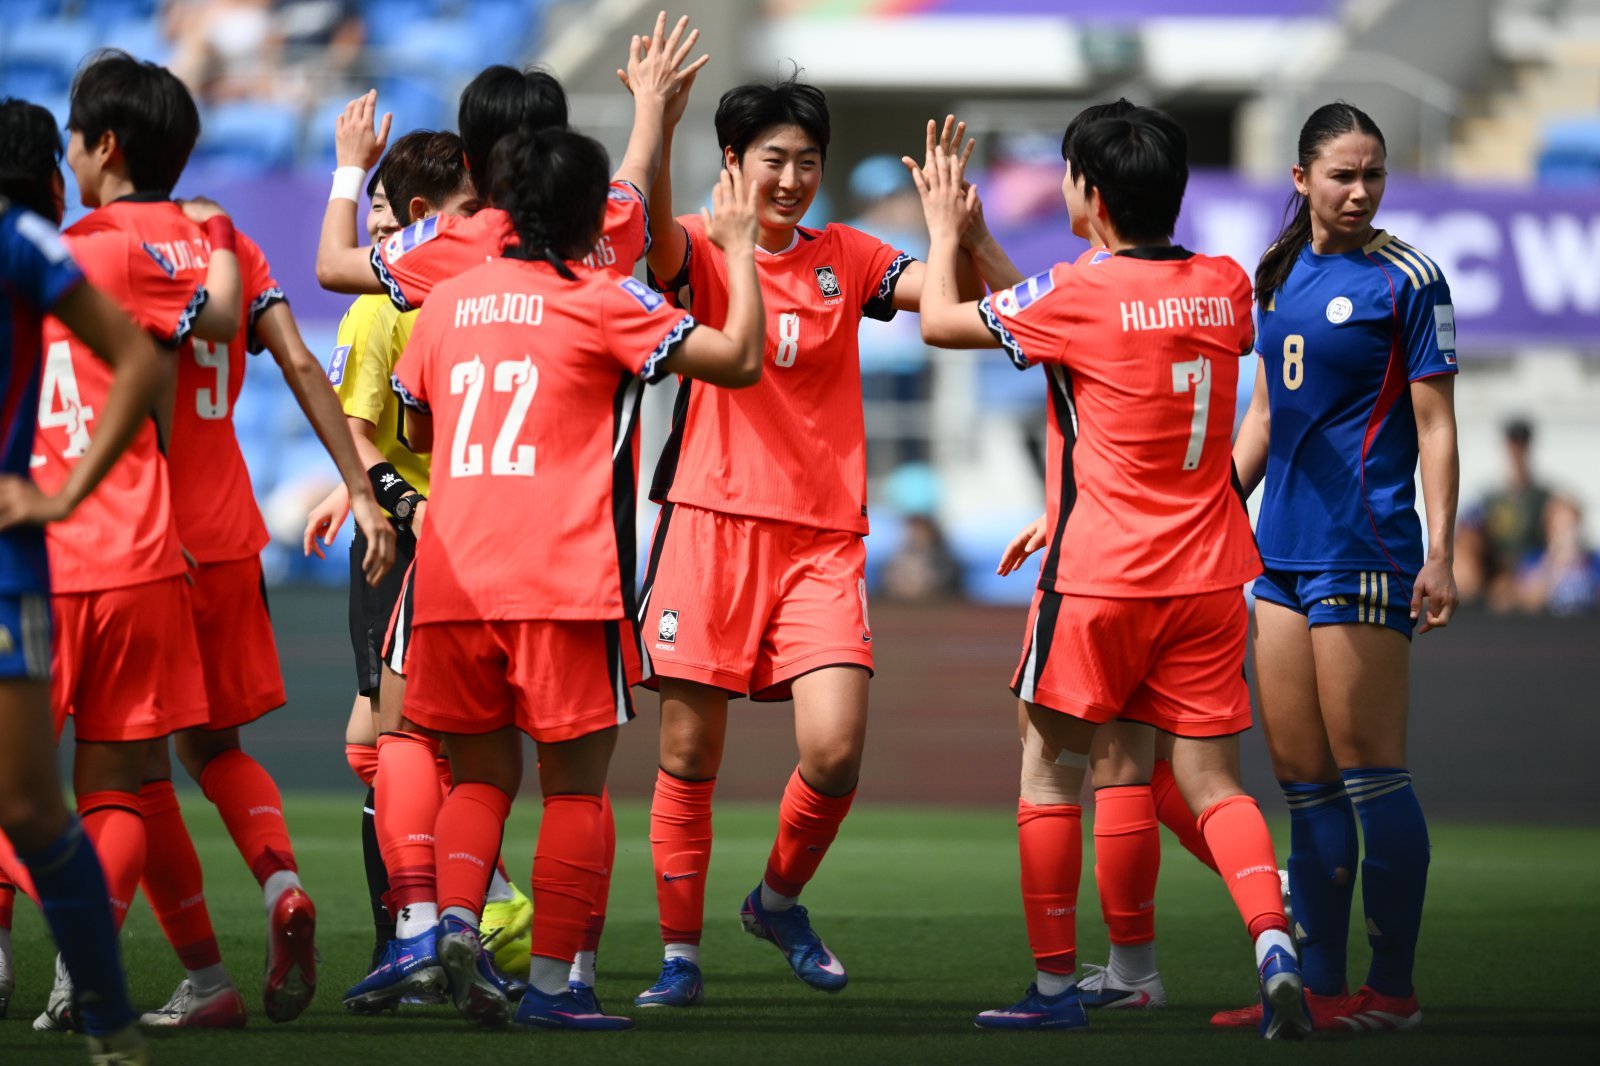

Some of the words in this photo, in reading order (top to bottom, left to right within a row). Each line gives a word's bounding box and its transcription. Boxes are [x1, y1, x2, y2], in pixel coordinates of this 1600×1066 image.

[454, 292, 544, 328] HYOJOO
[1120, 296, 1236, 332] HWAYEON
[775, 311, 800, 368] 8
[1283, 334, 1304, 390] 8
[29, 340, 94, 468] 4
[449, 354, 539, 478] 22
[1171, 353, 1212, 470] 7
[1236, 865, 1272, 880] KOREA
